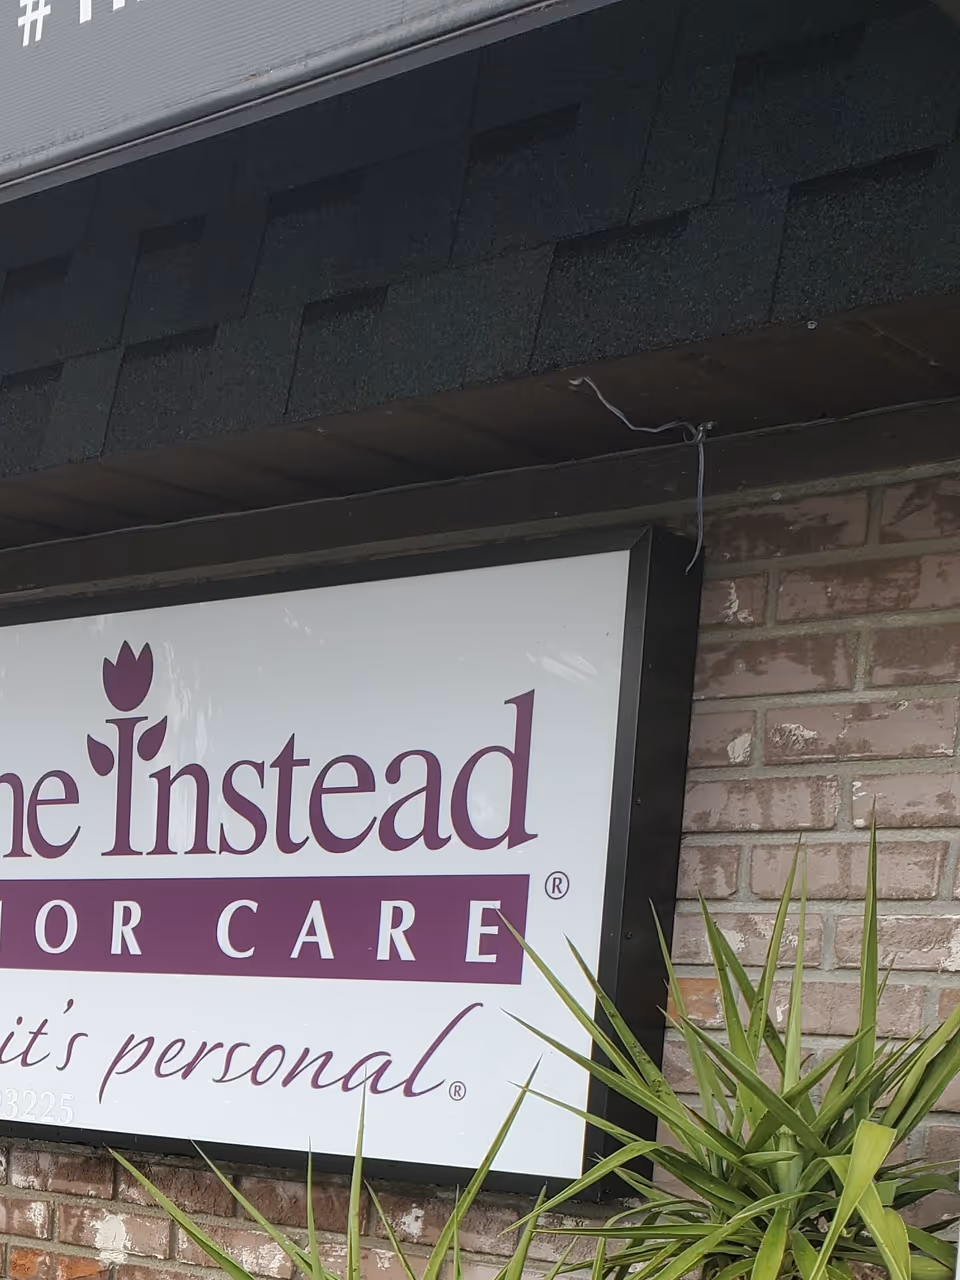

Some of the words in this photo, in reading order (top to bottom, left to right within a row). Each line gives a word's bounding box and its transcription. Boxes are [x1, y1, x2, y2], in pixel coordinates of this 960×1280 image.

[18, 0, 51, 47] #
[100, 689, 539, 858] Instead
[217, 898, 502, 964] CARE
[98, 1002, 483, 1104] personal
